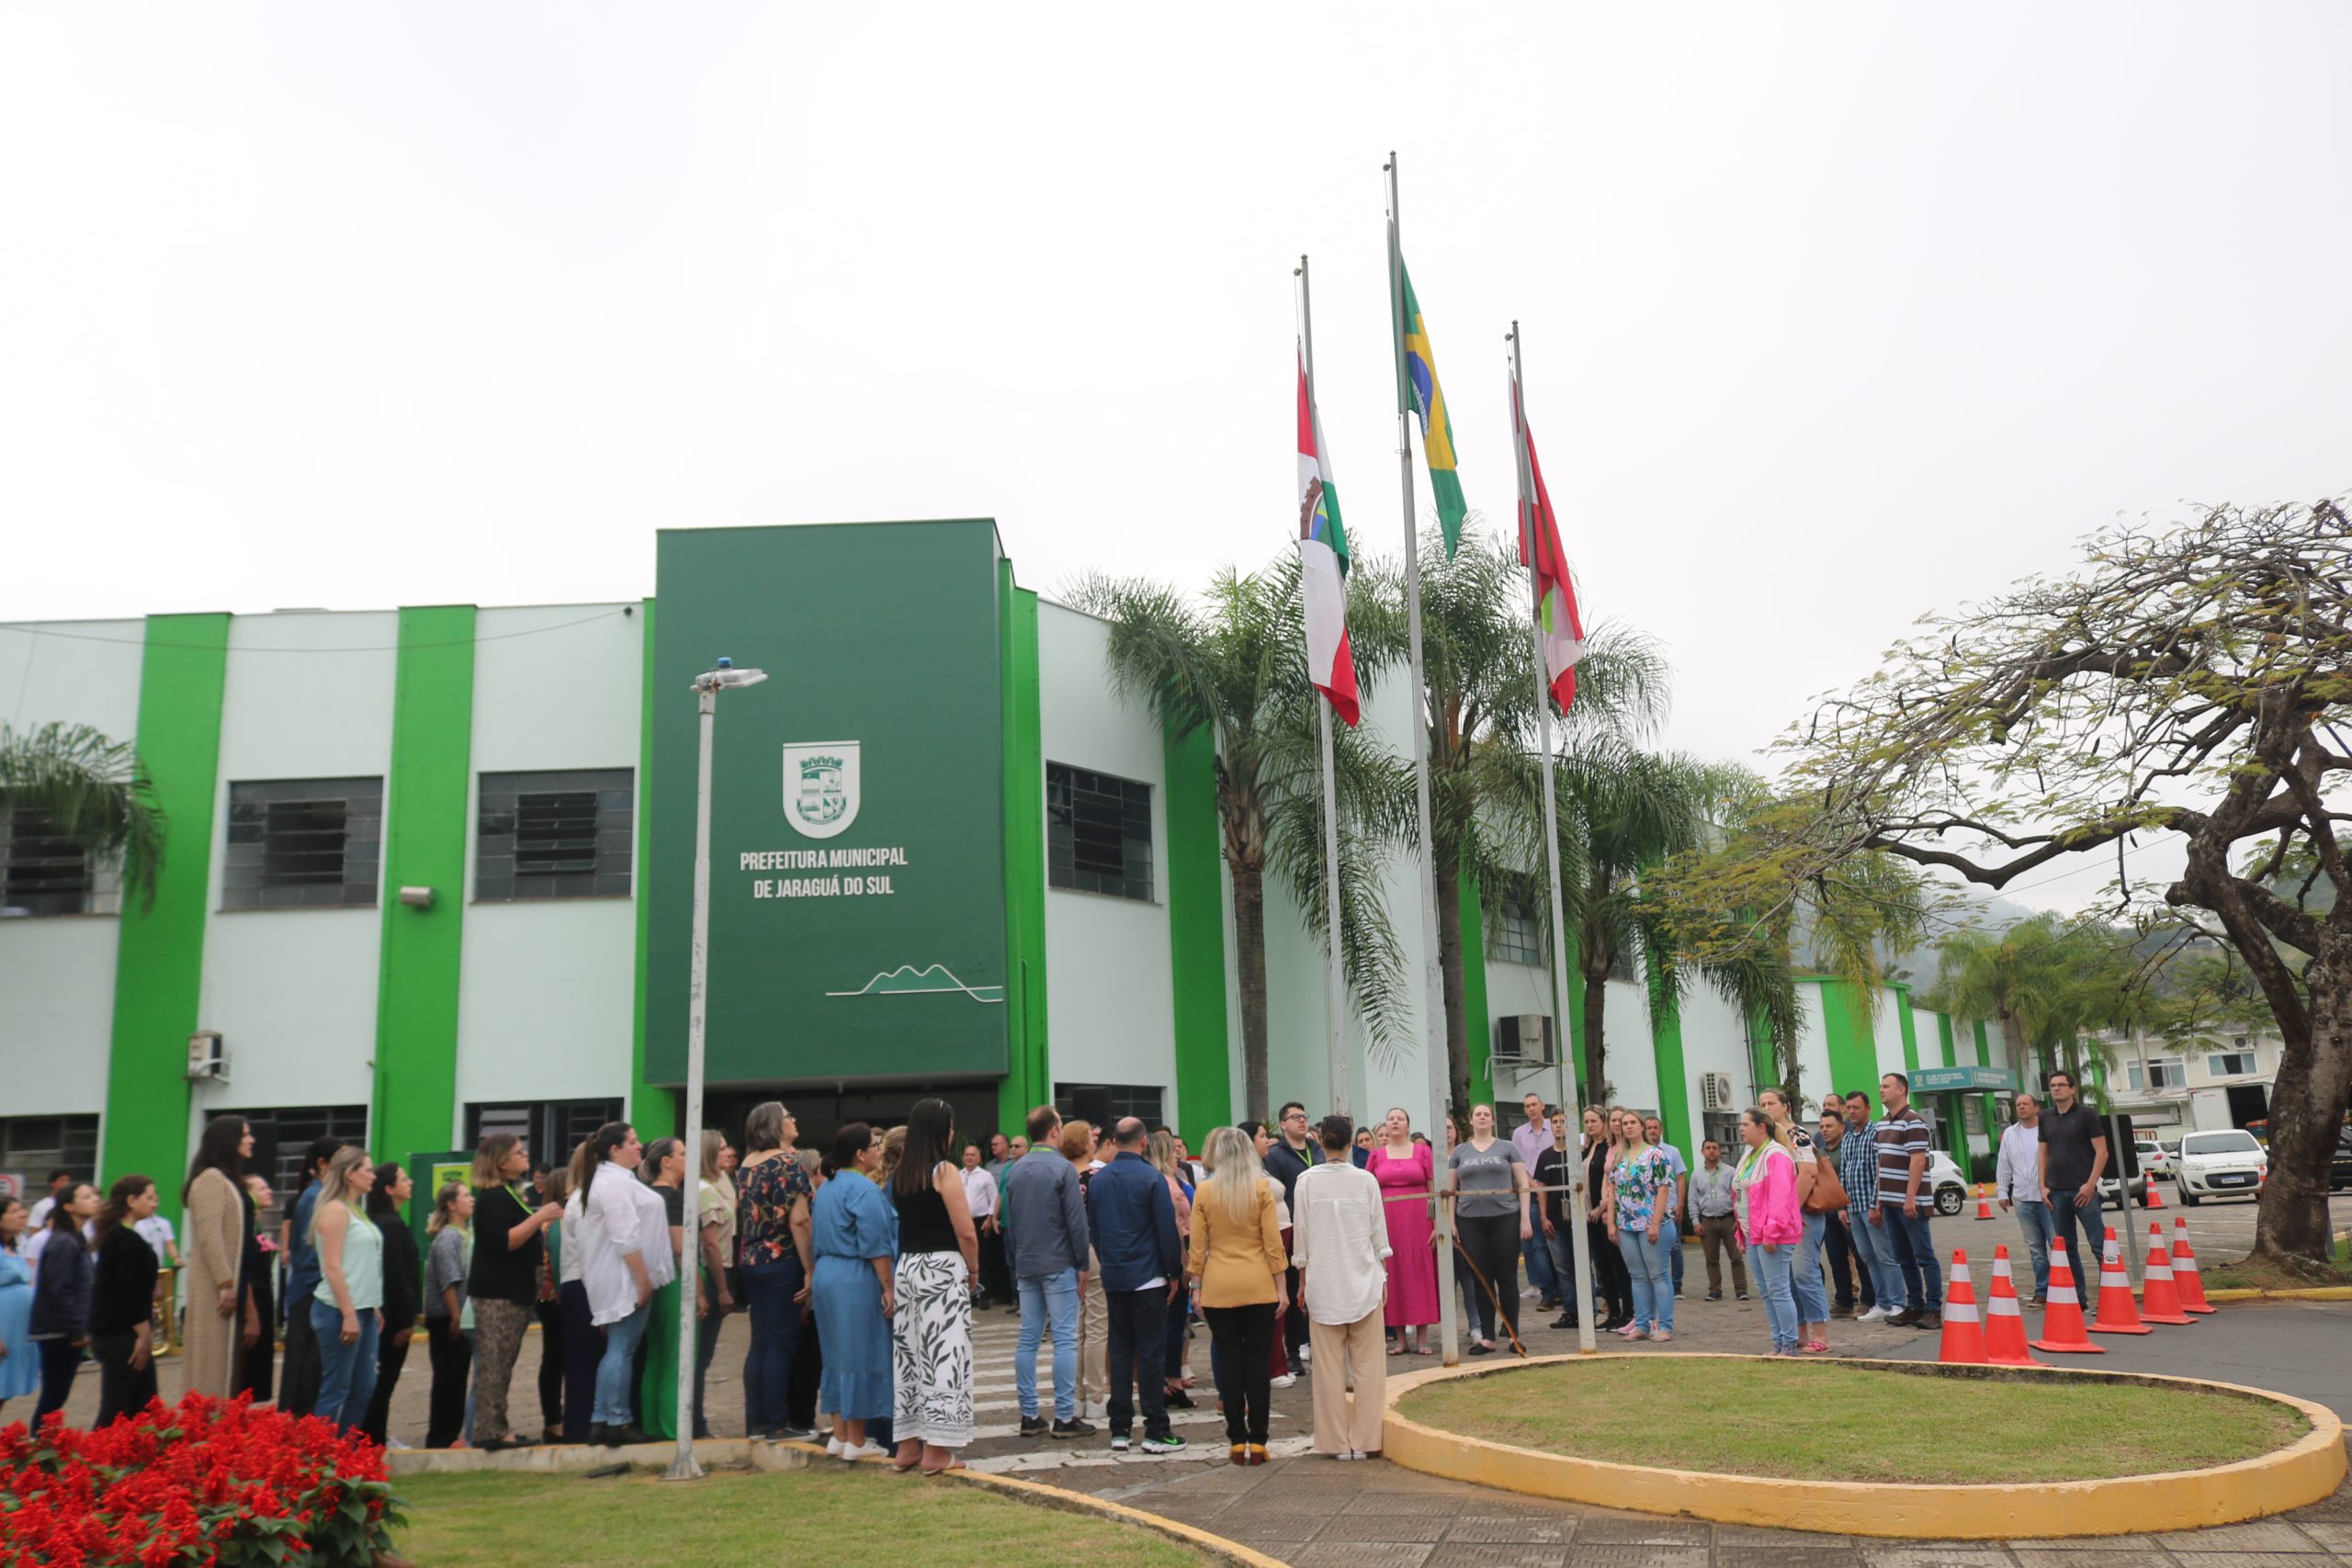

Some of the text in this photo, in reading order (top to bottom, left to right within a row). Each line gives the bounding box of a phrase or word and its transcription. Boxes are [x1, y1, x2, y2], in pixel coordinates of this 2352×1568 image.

[740, 847, 908, 871] PREFEITURA MUNICIPAL
[753, 874, 894, 898] DE JARAGUÁ DO SUL
